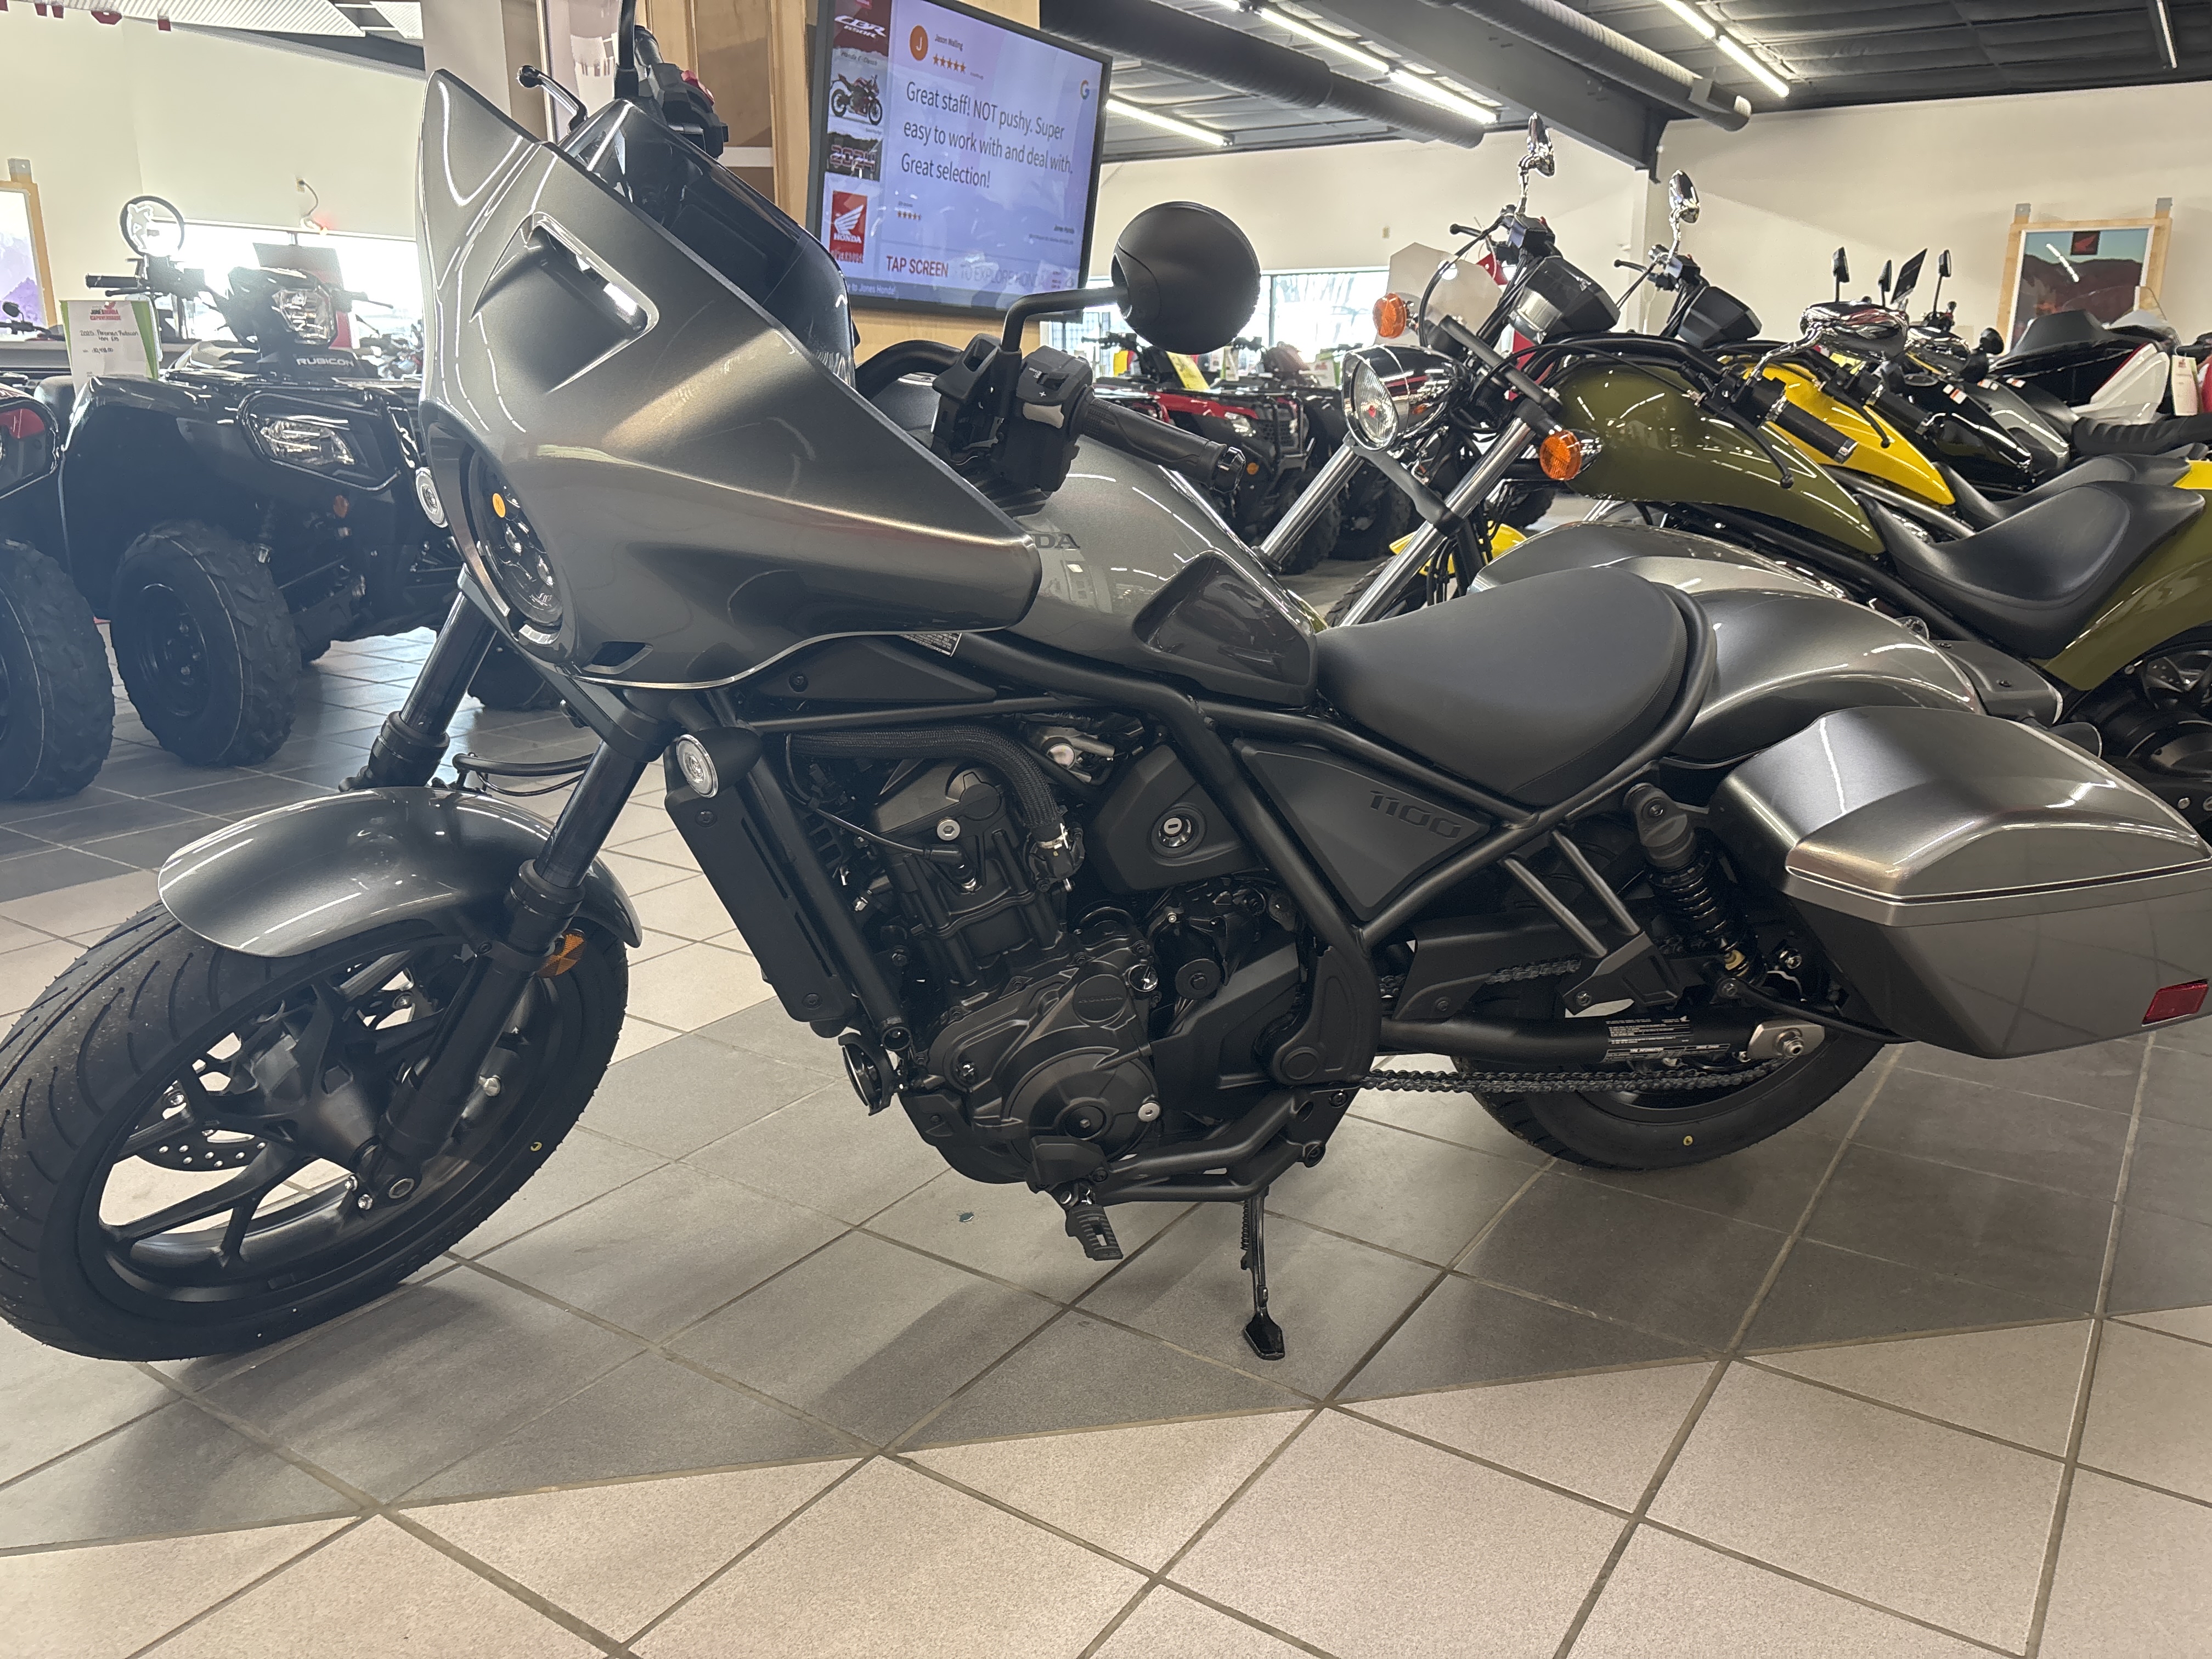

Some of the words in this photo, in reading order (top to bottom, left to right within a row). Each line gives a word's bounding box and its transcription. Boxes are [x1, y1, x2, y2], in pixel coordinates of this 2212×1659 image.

[834, 15, 887, 37] CBR
[916, 36, 923, 51] J
[907, 81, 940, 108] Great
[941, 93, 970, 116] staff!
[973, 99, 998, 122] NOT
[999, 110, 1032, 136] pushy.
[1035, 117, 1065, 142] Super
[830, 144, 876, 172] 2024
[904, 122, 932, 146] easy
[934, 125, 946, 145] to
[949, 132, 977, 152] work
[979, 137, 1002, 157] with
[1005, 144, 1025, 162] and
[1026, 146, 1048, 168] deal
[1050, 154, 1073, 174] with.
[901, 153, 934, 177] Great
[936, 161, 991, 188] selection!
[833, 232, 862, 244] HONDA
[886, 255, 906, 273] TAP
[909, 258, 949, 278] SCREEN
[296, 358, 354, 367] RUBICON
[1028, 533, 1080, 549] DA
[1370, 790, 1463, 839] 1100
